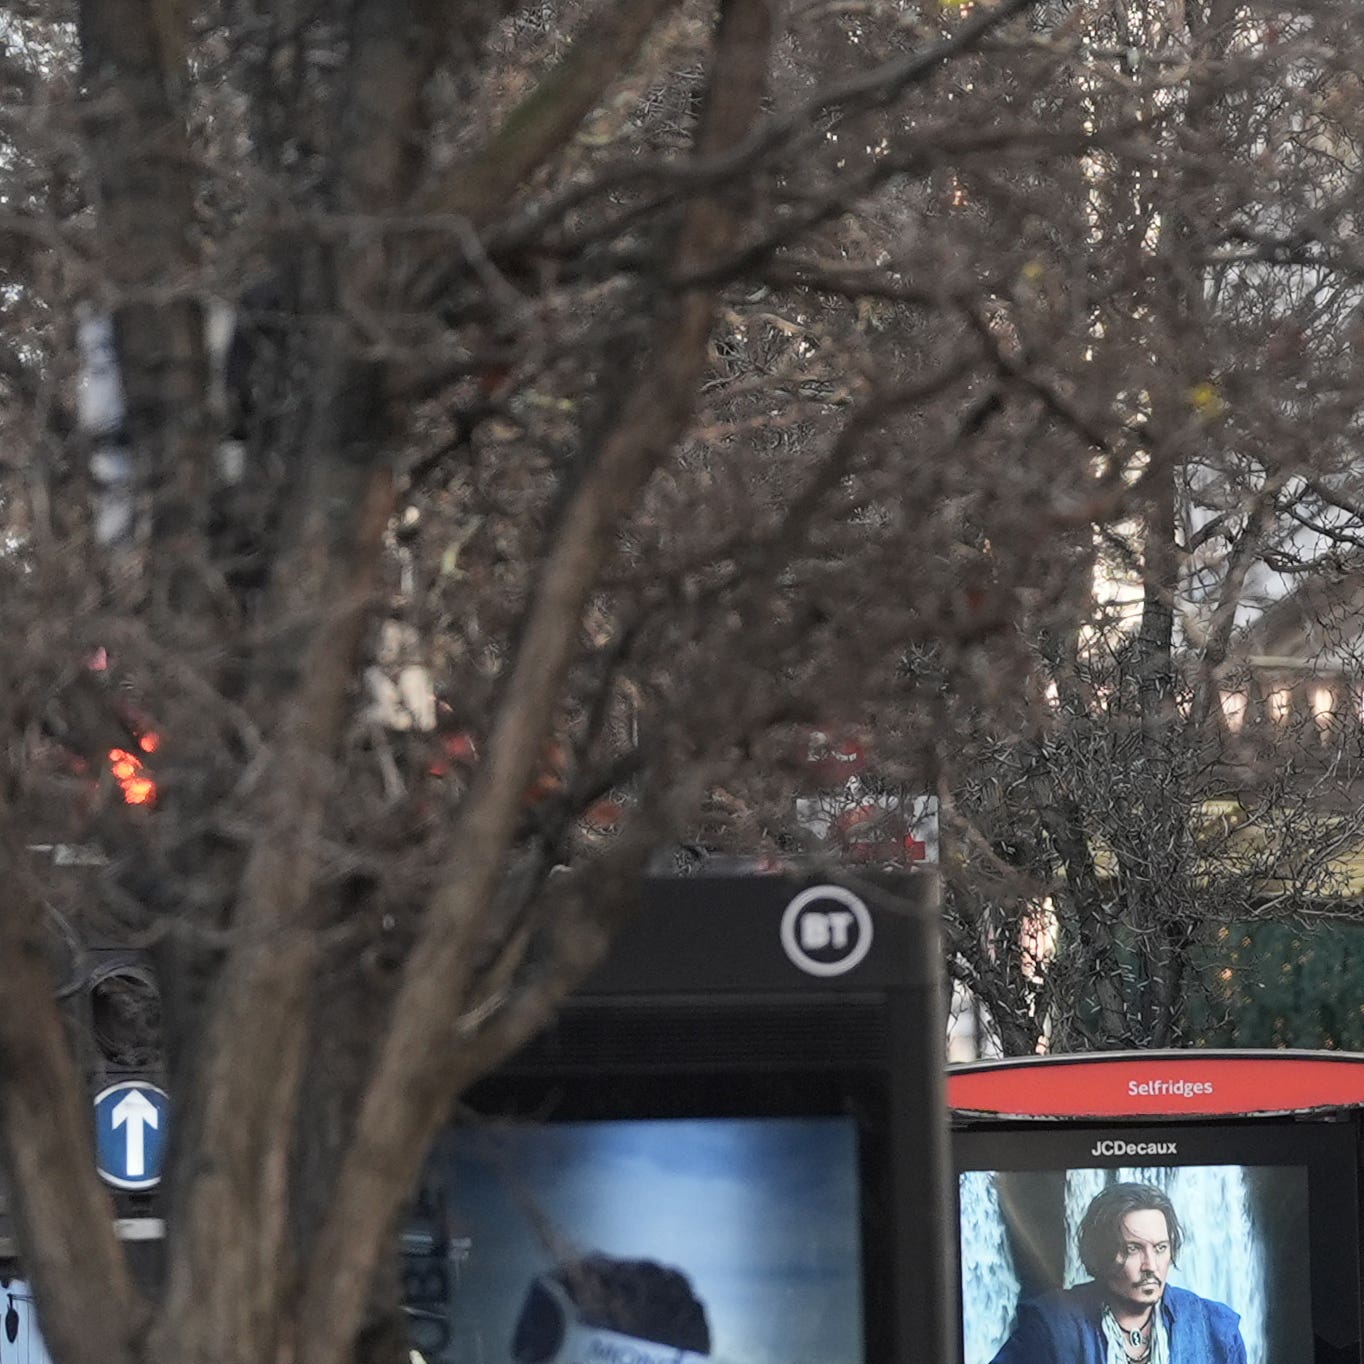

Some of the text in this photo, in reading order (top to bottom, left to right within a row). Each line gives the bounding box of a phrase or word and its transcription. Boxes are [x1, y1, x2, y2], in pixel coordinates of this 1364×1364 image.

[800, 911, 854, 950] BT
[1128, 1080, 1213, 1098] Selfridges
[1091, 1140, 1177, 1156] JCDecaux
